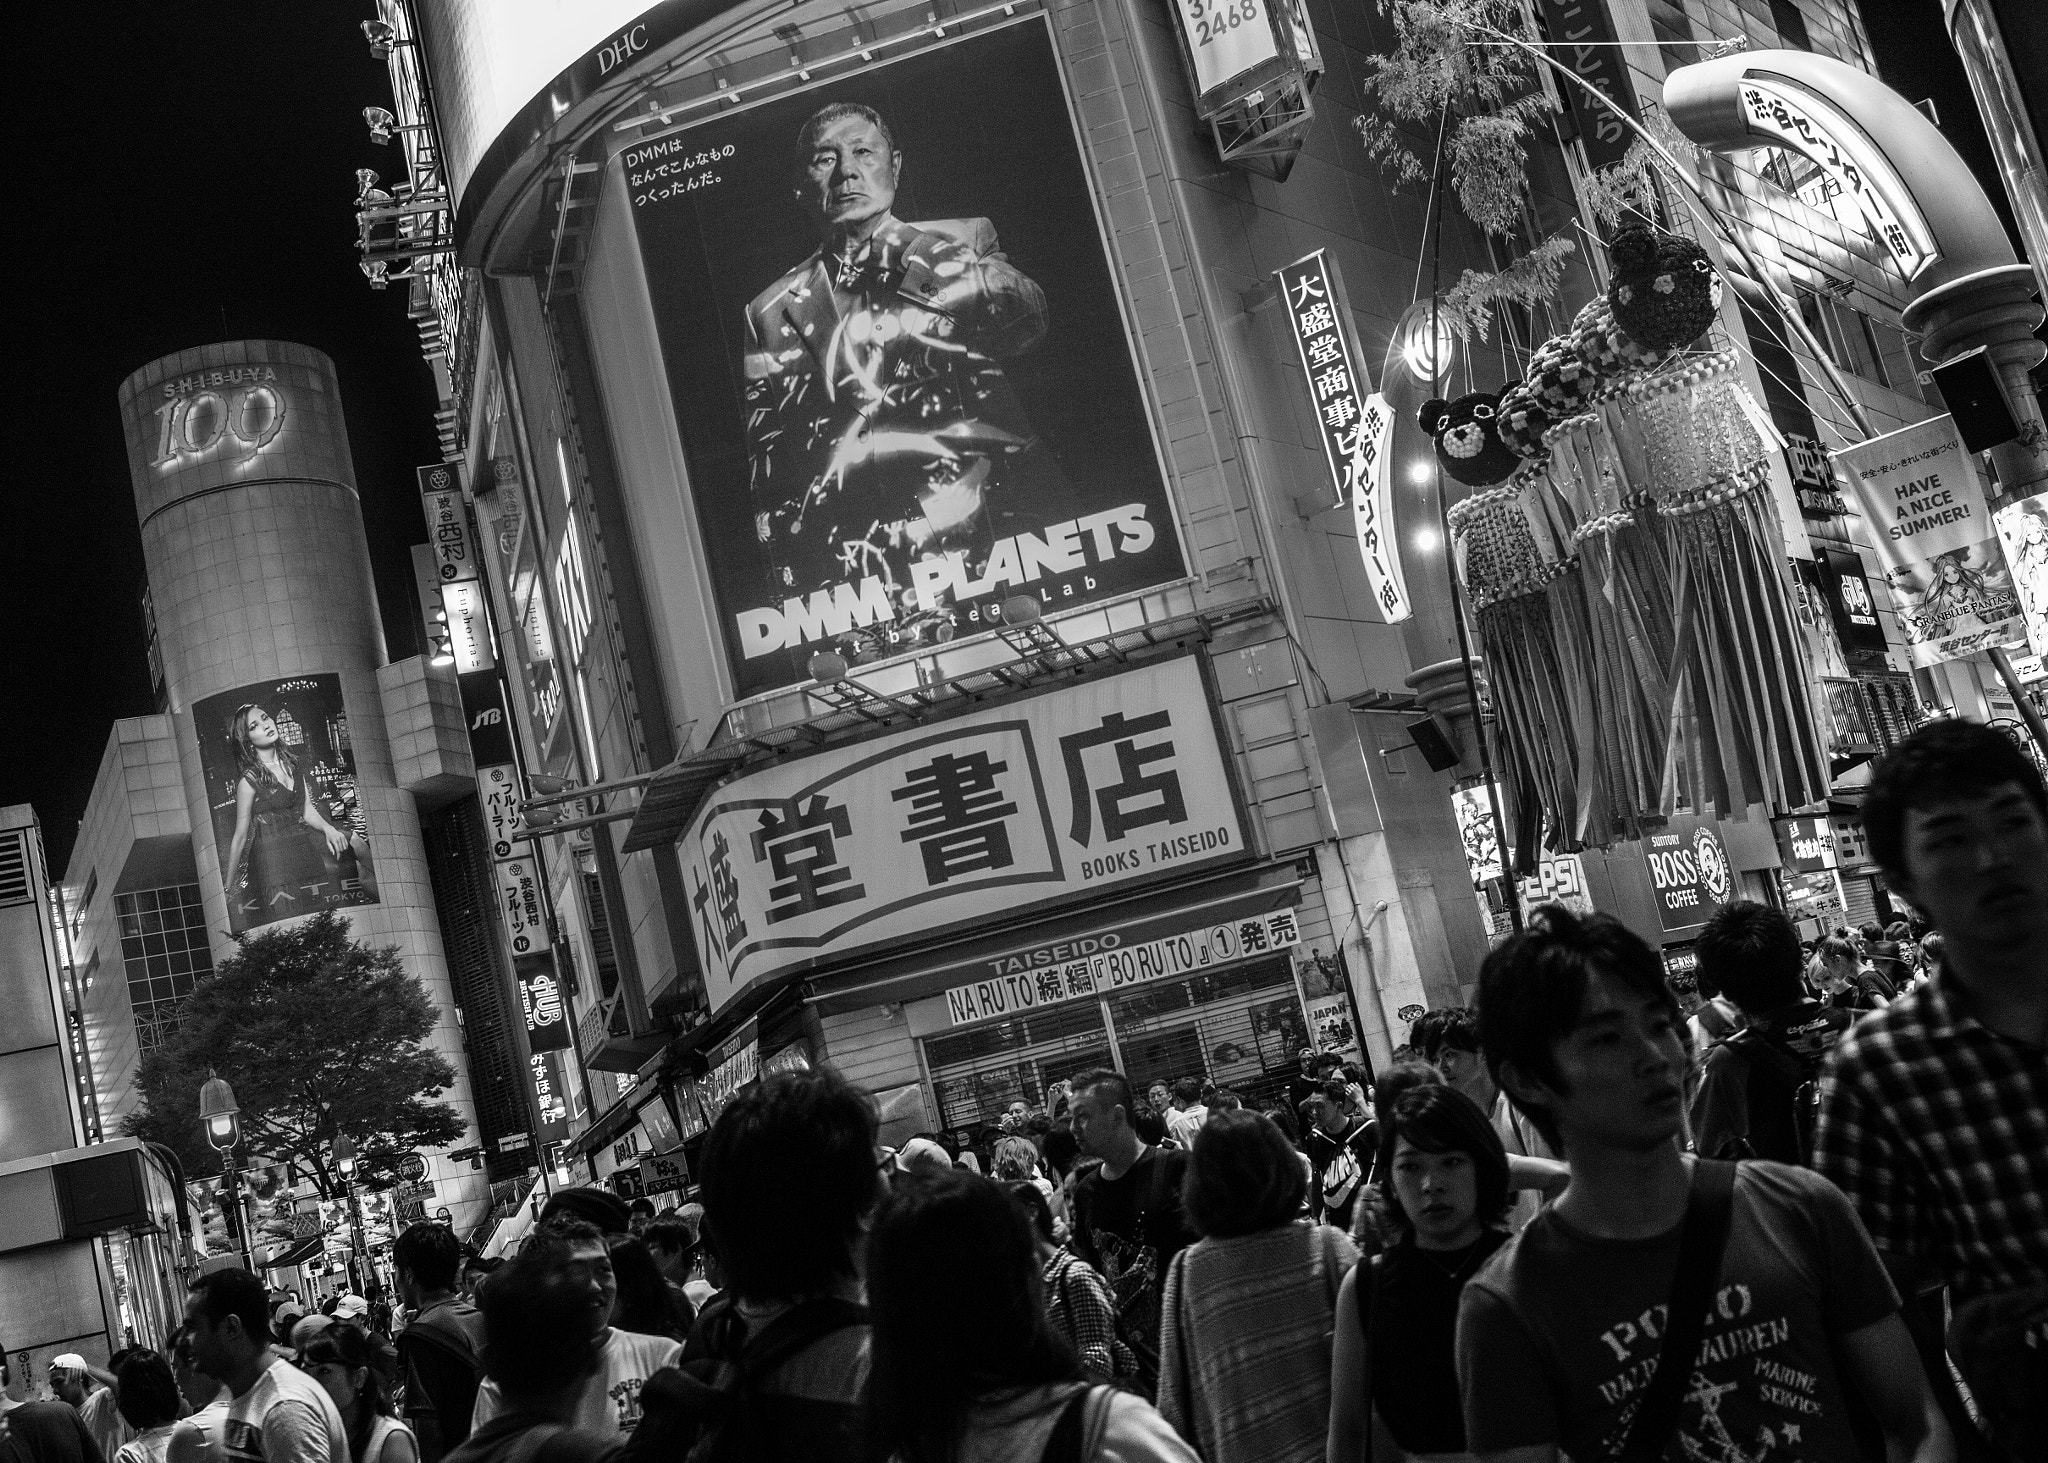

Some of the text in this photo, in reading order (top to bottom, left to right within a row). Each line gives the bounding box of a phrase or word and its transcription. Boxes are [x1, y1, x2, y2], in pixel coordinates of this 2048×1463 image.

[1195, 0, 1257, 47] 2468
[597, 24, 650, 75] DHC
[626, 139, 683, 168] DMMは
[631, 144, 735, 187] なんでこんなもの
[1745, 90, 1912, 258] 渋谷センター街
[635, 170, 721, 207] つくったんだ。
[164, 367, 276, 398] SHIBUYA
[151, 384, 286, 468] 109
[1894, 473, 1942, 500] HAVE
[1896, 489, 1954, 520] A NICE
[1357, 406, 1398, 615] 渋谷センター街
[1889, 503, 1971, 541] SUMMER!
[736, 504, 1155, 660] DMM PLANETS
[457, 588, 478, 656] Euphoria
[888, 628, 921, 645] by
[1914, 604, 1970, 628] GRANBLUE
[473, 707, 502, 731] JTB
[487, 792, 504, 838] パーラー
[501, 783, 520, 829] フルーツ
[694, 709, 1188, 970] 大盛堂書店
[1081, 827, 1230, 880] BOOKS TAISEIDO
[1651, 833, 1680, 848] SUNTORY
[1648, 848, 1698, 889] BOSS
[238, 878, 363, 915] KATE
[324, 891, 365, 903] TOKYO
[505, 886, 524, 933] フルーツ
[519, 876, 539, 927] 渋谷西村
[1665, 888, 1699, 909] COFFEE
[516, 939, 528, 949] 1F
[988, 934, 1121, 976] TAISEIDO
[519, 980, 535, 1031] BRITISH PUB
[528, 975, 562, 1026] HUB
[1313, 1002, 1347, 1020] JAPAN
[530, 1053, 556, 1125] みずほ銀行
